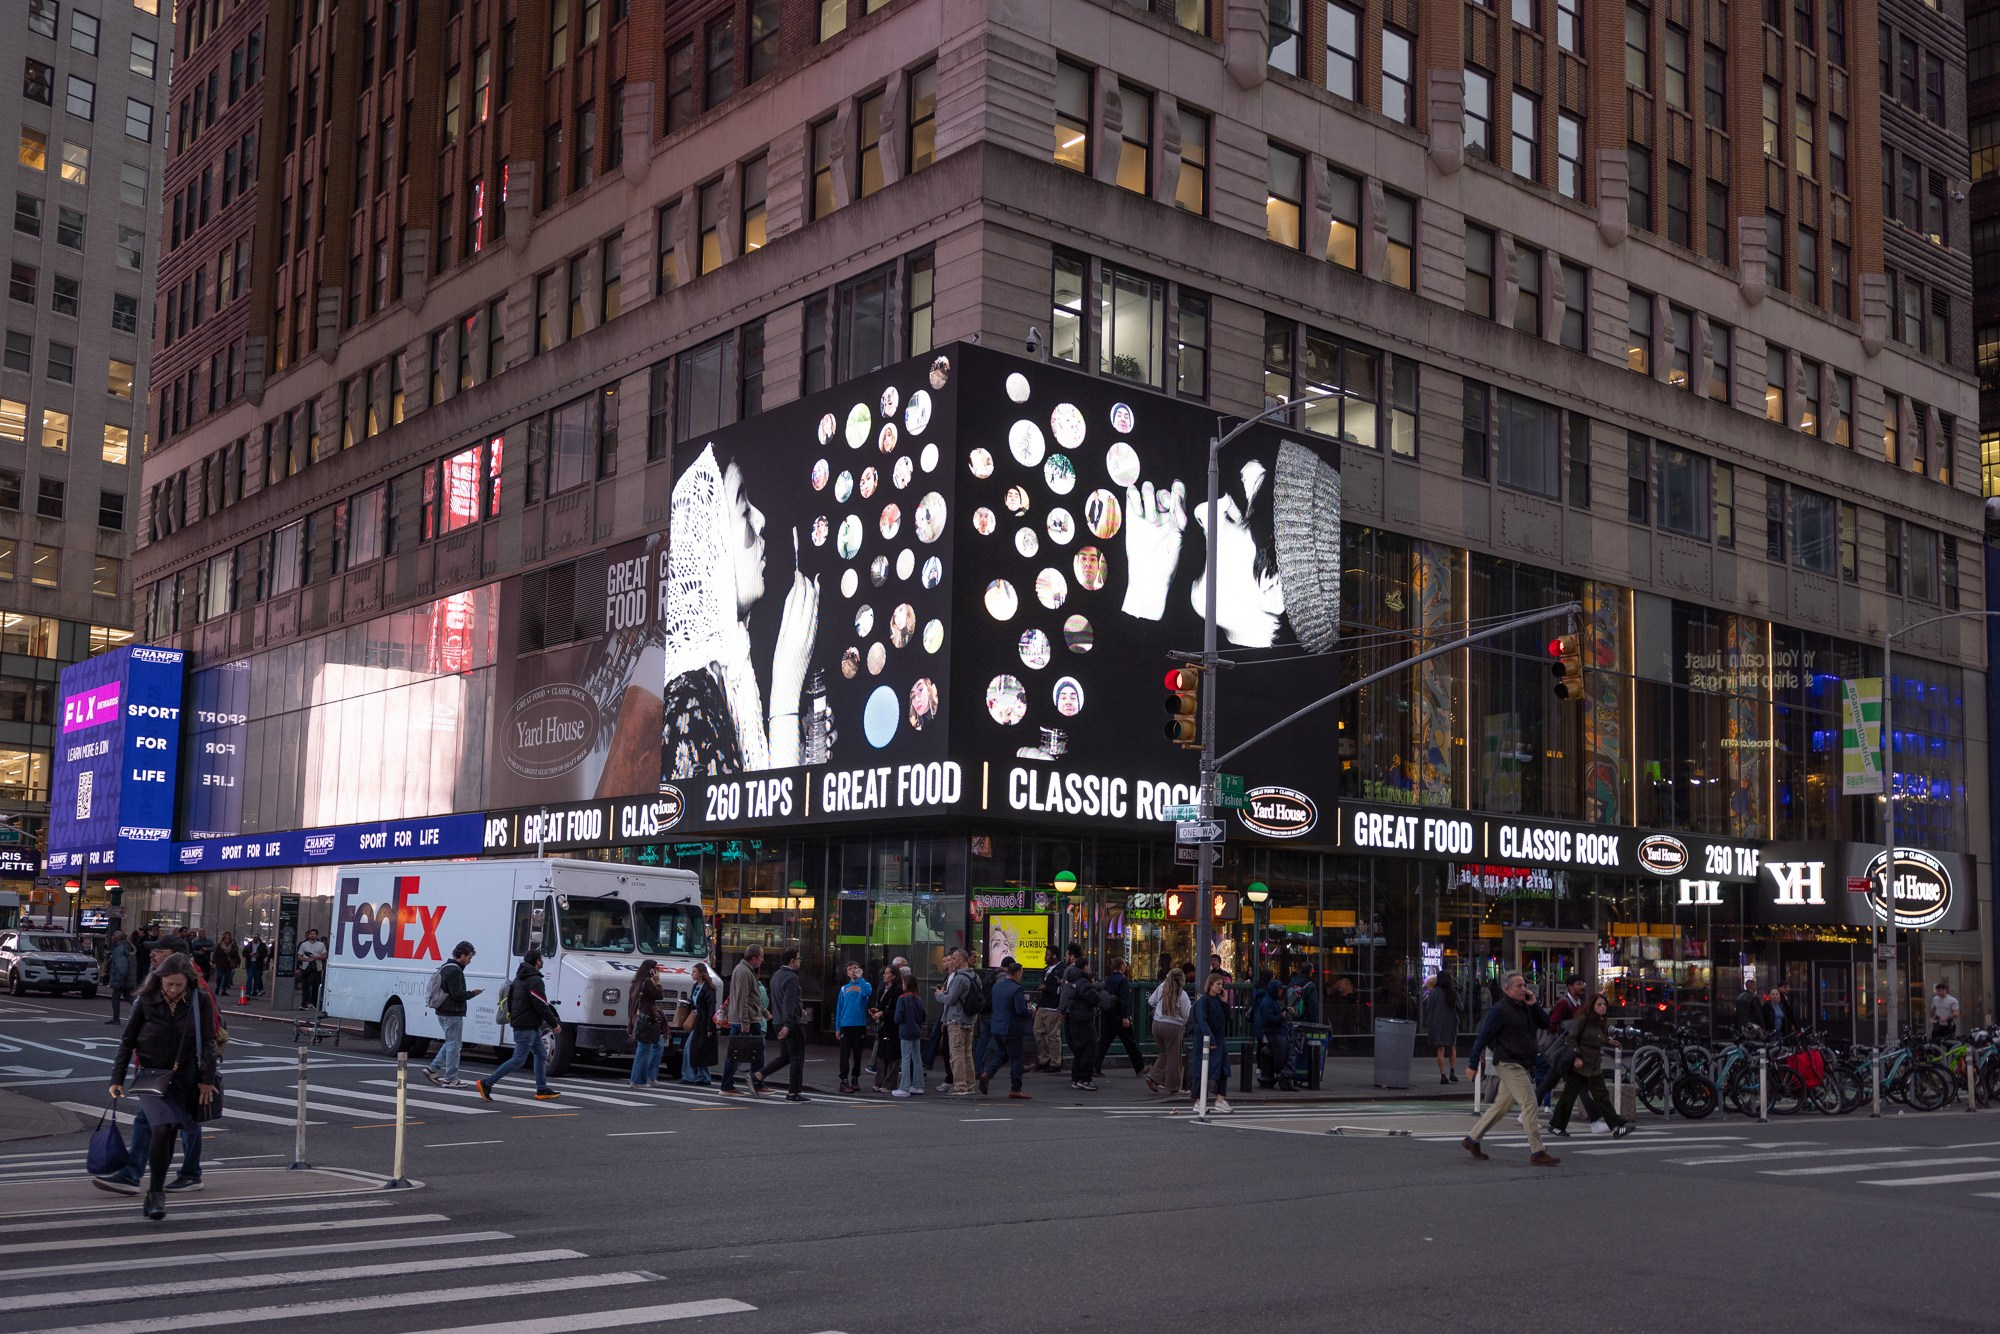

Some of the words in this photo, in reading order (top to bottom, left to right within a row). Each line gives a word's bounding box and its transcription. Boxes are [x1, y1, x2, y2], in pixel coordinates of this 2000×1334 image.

[607, 555, 650, 595] GREAT
[605, 588, 647, 633] FOOD
[134, 650, 181, 662] CHAMPS
[516, 695, 532, 712] GREAT
[532, 690, 546, 702] FOOD
[551, 687, 572, 696] CLASSIC
[571, 688, 586, 702] ROCK
[64, 695, 97, 727] FLX
[96, 696, 119, 711] REWARDS
[128, 704, 179, 720] SPORT
[516, 718, 544, 748] Yard
[545, 716, 585, 744] House
[1849, 687, 1871, 768] #GarmentDistrict
[67, 744, 82, 762] LEARN
[82, 742, 95, 759] MORE
[99, 740, 109, 755] JOIN
[136, 736, 168, 750] FOR
[132, 769, 166, 782] LIFE
[1226, 776, 1231, 789] 7
[822, 767, 891, 814] GREAT
[897, 760, 962, 807] FOOD
[1009, 767, 1128, 819] CLASSIC
[705, 781, 740, 822] 260
[745, 776, 793, 819] TAPS
[1221, 793, 1243, 807] Fashion
[1251, 801, 1275, 820] Yard
[1276, 803, 1307, 823] House
[120, 827, 169, 838] CHAMPS
[524, 812, 565, 845] GREAT
[567, 808, 602, 841] FOOD
[621, 803, 659, 837] CLAS
[1182, 828, 1197, 837] ONE
[1202, 827, 1218, 836] WAY
[1354, 811, 1419, 850] GREAT
[1424, 818, 1473, 854] FOOD
[305, 836, 335, 850] CHAMPS
[359, 831, 388, 850] SPORT
[394, 830, 412, 848] FOR
[419, 828, 440, 846] LIFE
[1500, 825, 1572, 862] CLASSIC
[1575, 833, 1619, 867] ROCK
[0, 852, 21, 861] RIS
[50, 854, 67, 866] CHAMPS
[70, 852, 83, 866] SPO
[89, 851, 100, 864] FOR
[103, 850, 115, 864] LIFE
[181, 848, 203, 860] CHAMPS
[221, 845, 242, 860] SPORT
[246, 844, 260, 859] FOR
[265, 842, 281, 857] LIFE
[1182, 849, 1196, 859] ONE
[1646, 847, 1661, 861] Yard
[1661, 848, 1682, 863] House
[1705, 844, 1733, 875] 260
[1764, 861, 1826, 905] YH
[1879, 872, 1906, 898] Yrd
[1905, 874, 1941, 901] House
[335, 875, 448, 961] FedEx
[1019, 940, 1048, 949] PLURIBUS
[606, 960, 691, 975] FeEx
